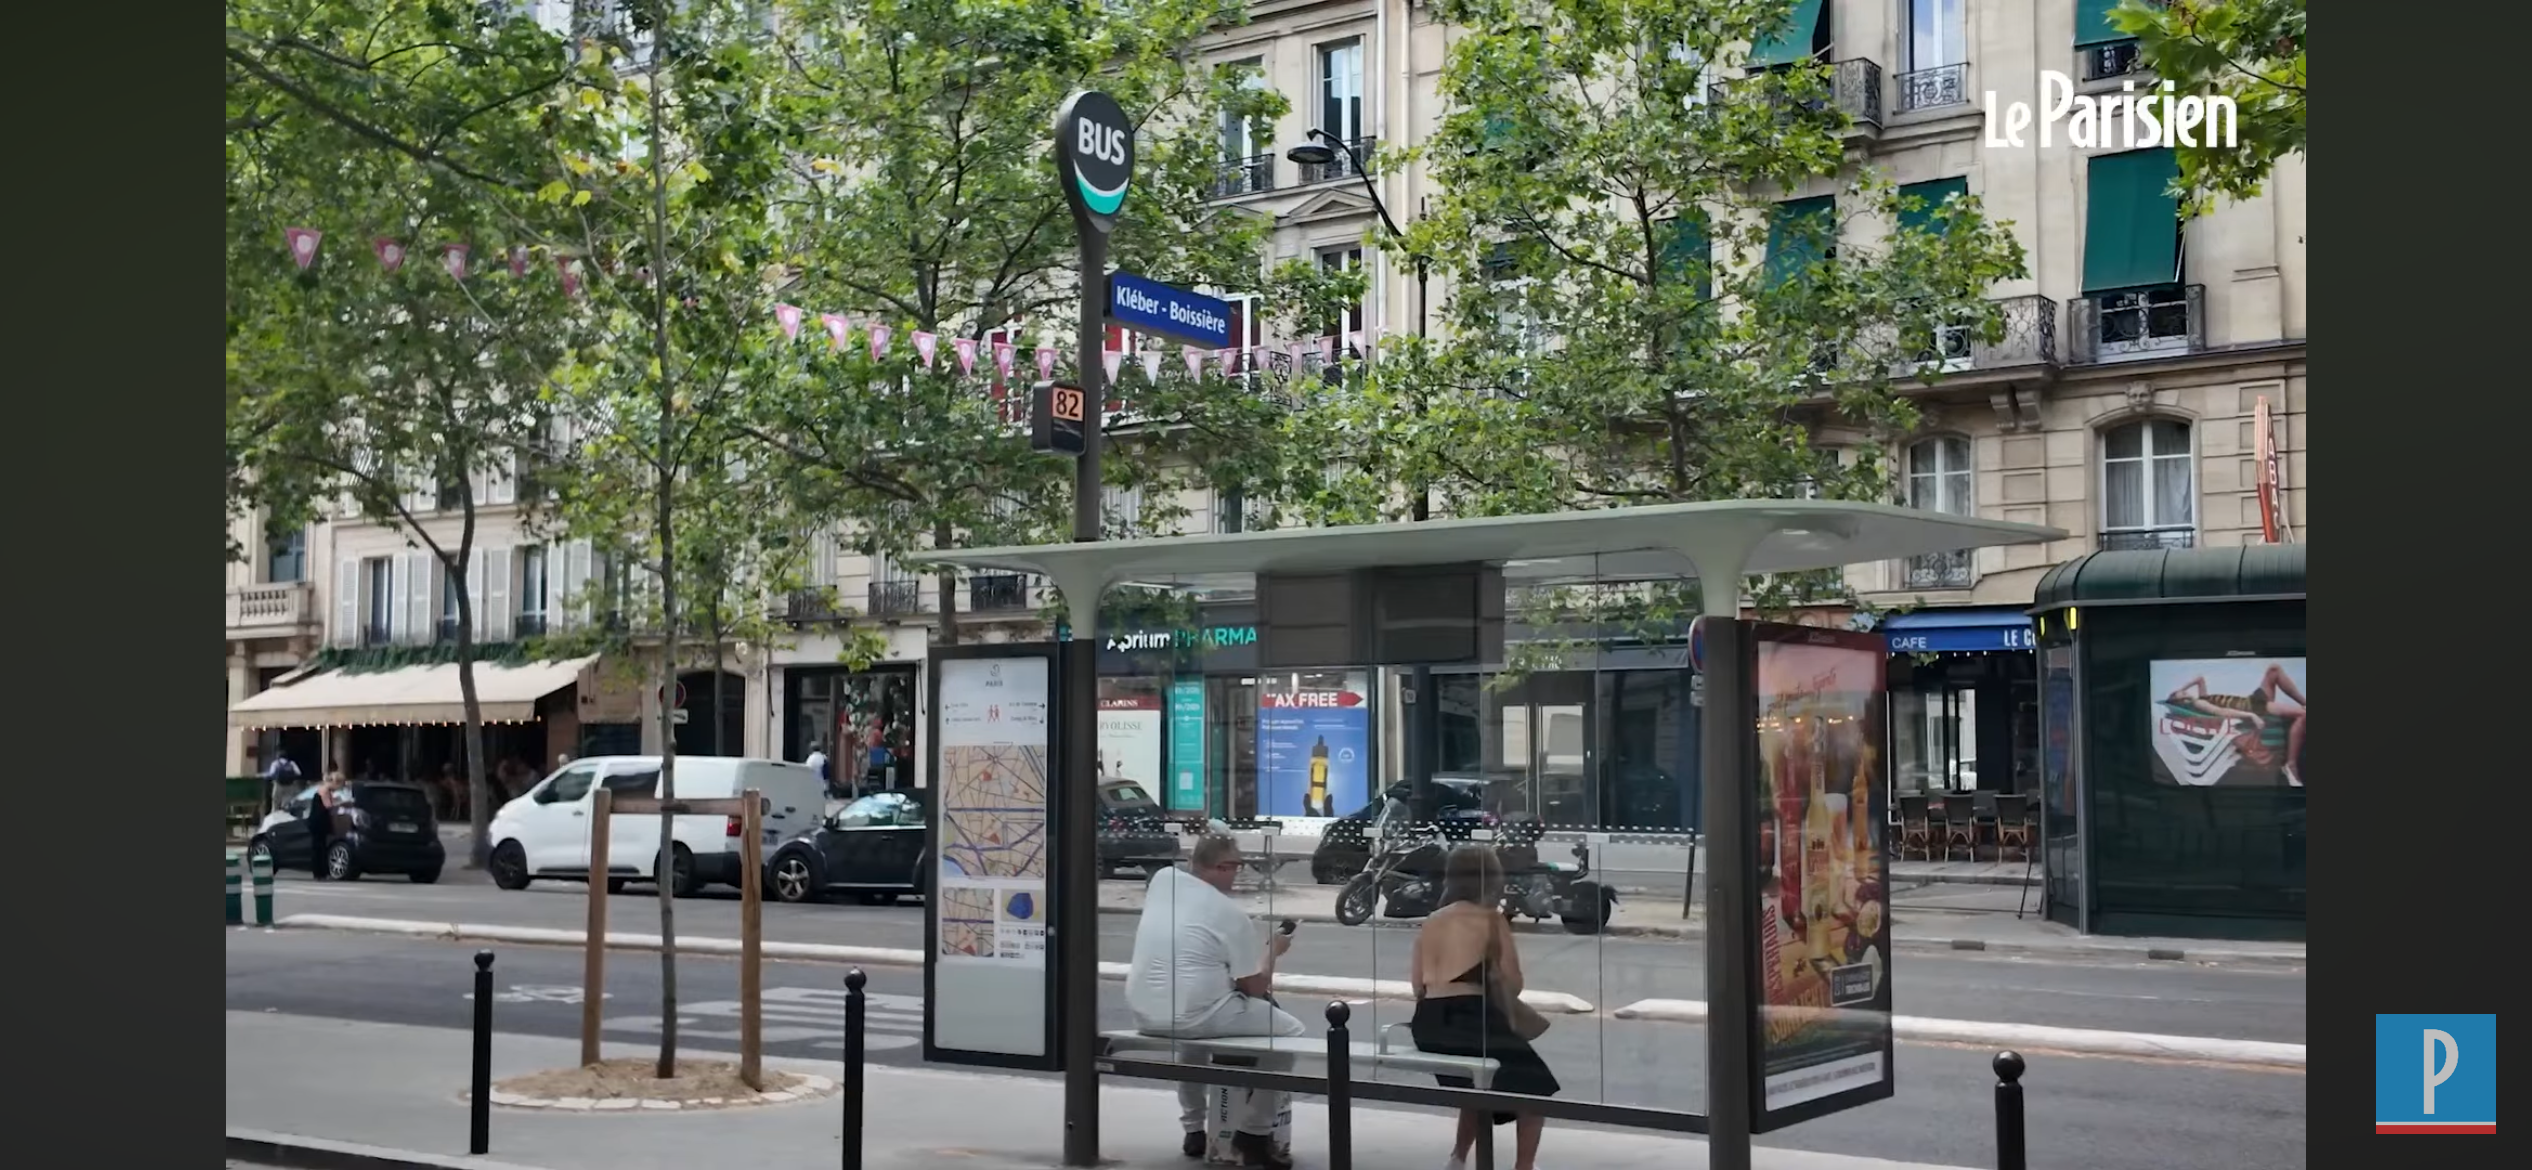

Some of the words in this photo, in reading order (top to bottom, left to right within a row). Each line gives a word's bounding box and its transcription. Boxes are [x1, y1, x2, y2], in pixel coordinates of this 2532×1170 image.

[1078, 116, 1126, 166] BUS
[1116, 285, 1160, 315] Kléber
[1169, 300, 1226, 334] Boissière
[1056, 390, 1079, 418] 82
[1891, 636, 1927, 649] CAFE
[2004, 629, 2018, 647] LE
[1298, 692, 1338, 707] FREE
